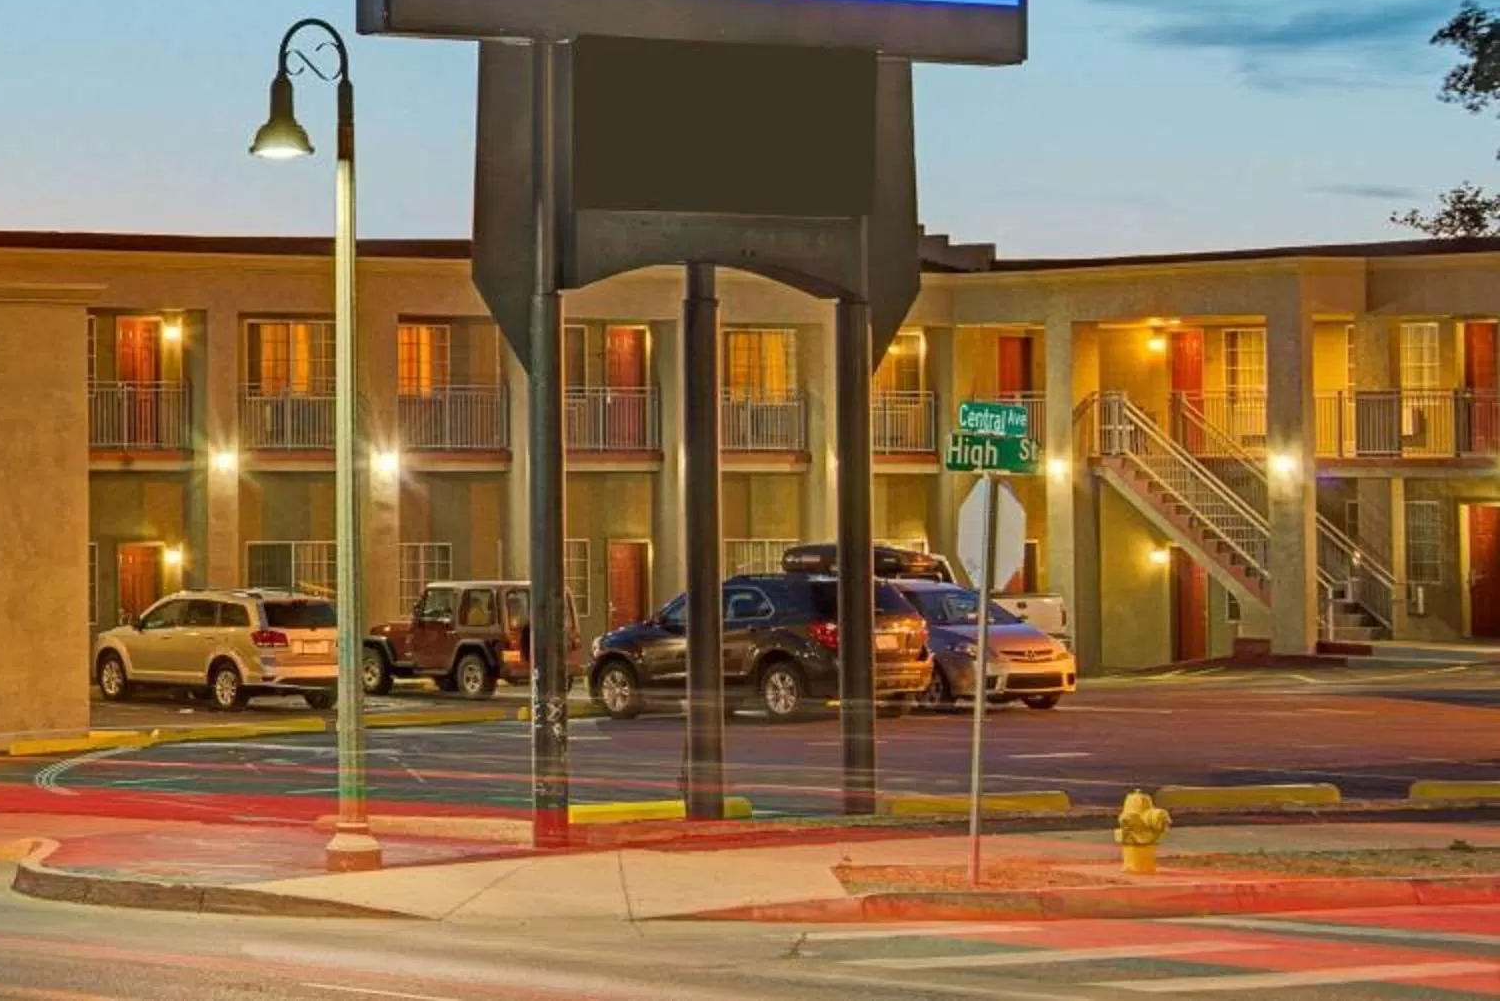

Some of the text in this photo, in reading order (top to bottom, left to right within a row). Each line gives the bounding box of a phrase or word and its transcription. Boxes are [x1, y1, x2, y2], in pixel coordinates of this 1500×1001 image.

[960, 404, 1006, 431] Central
[947, 433, 1037, 470] High St
